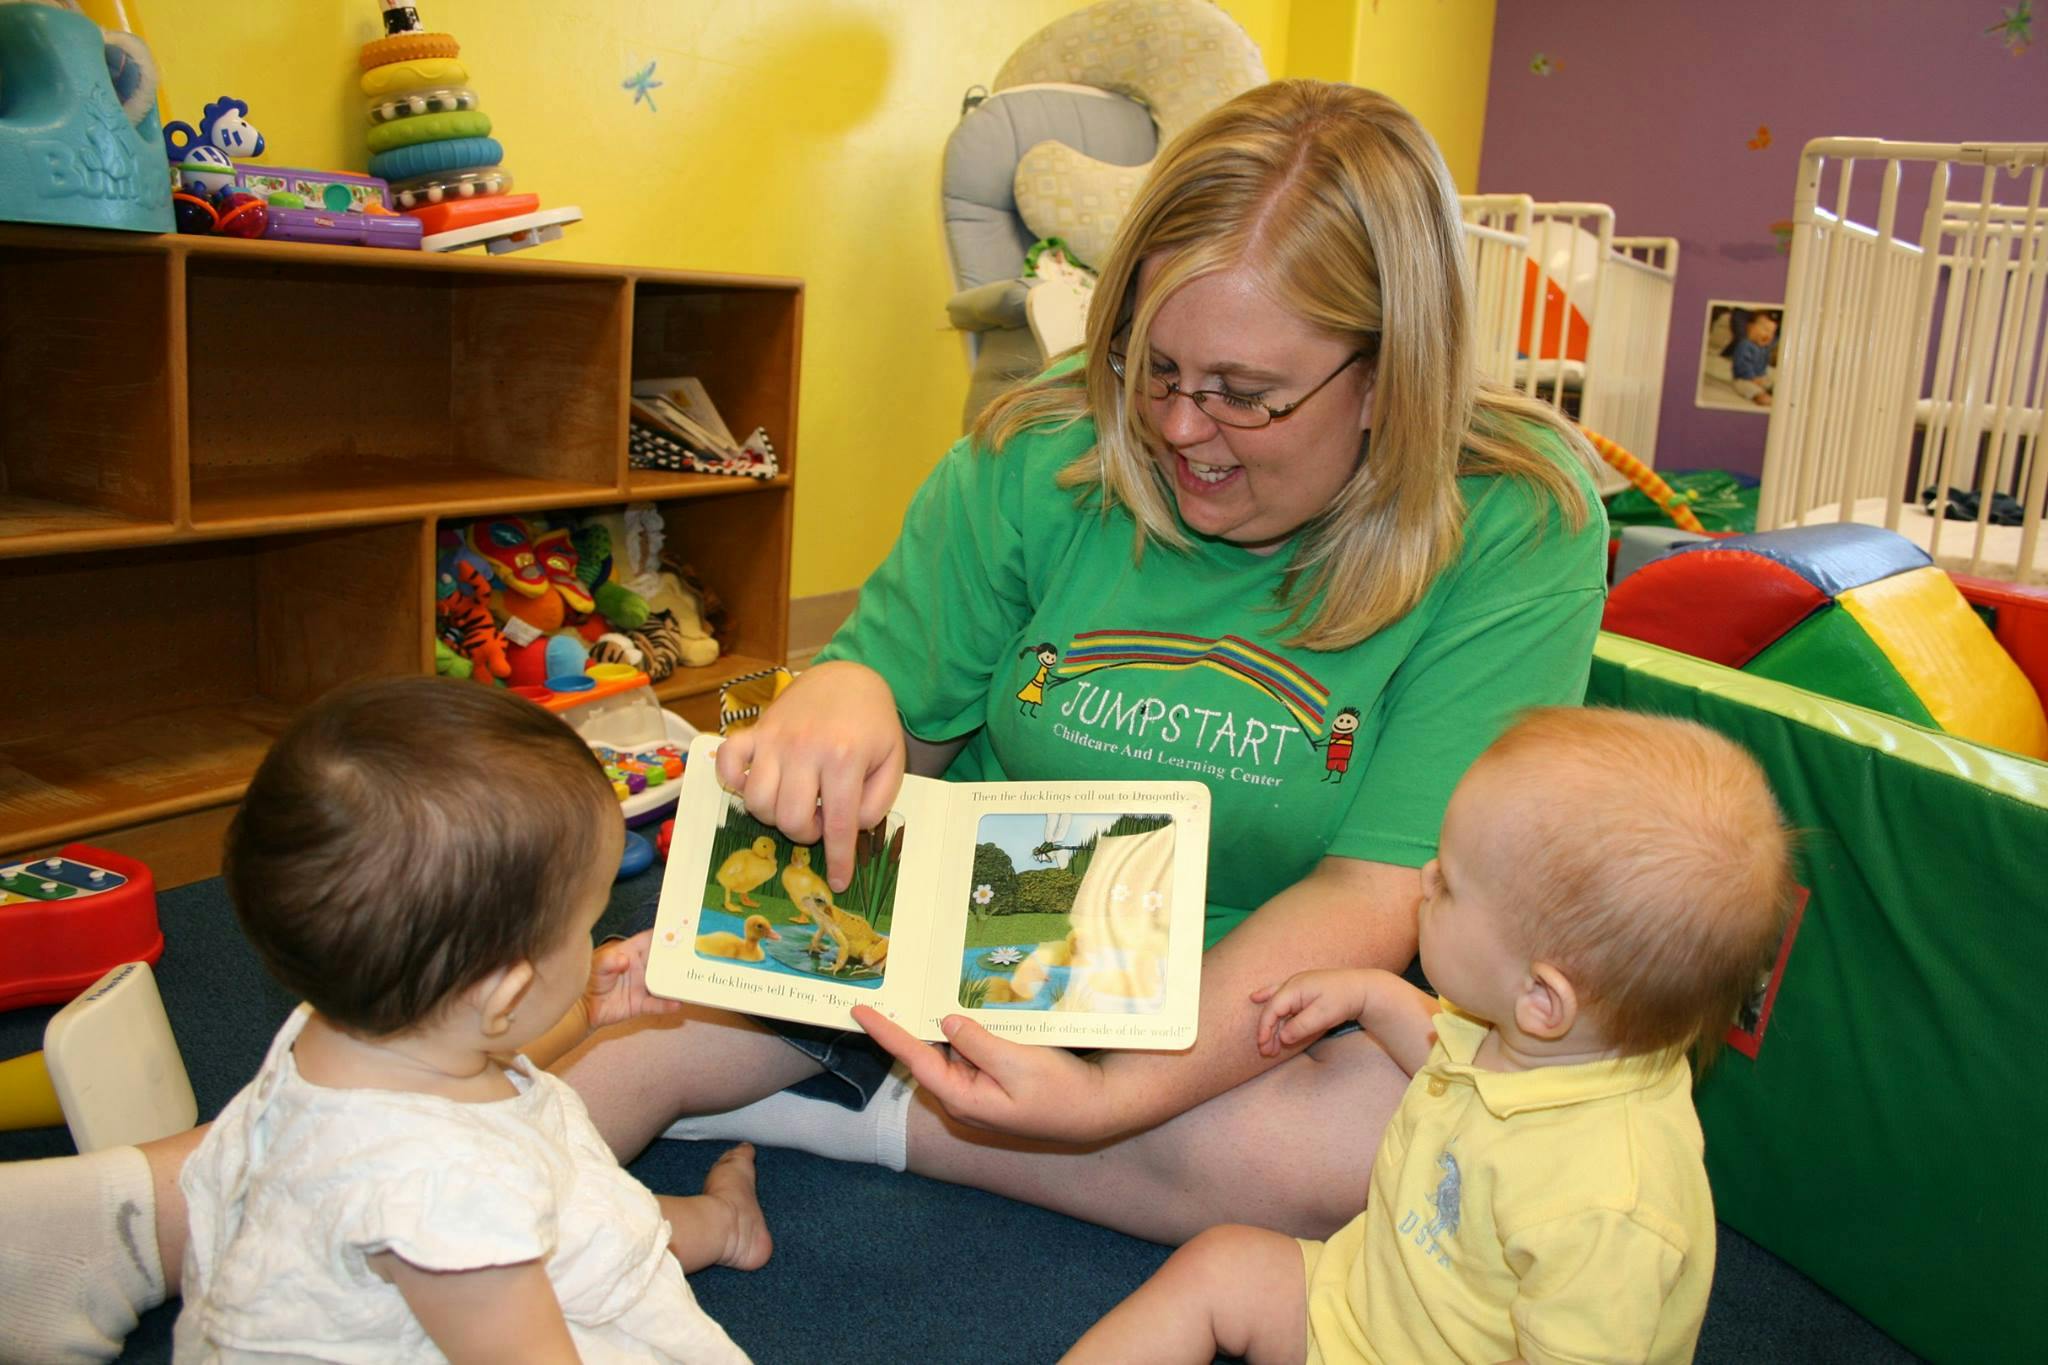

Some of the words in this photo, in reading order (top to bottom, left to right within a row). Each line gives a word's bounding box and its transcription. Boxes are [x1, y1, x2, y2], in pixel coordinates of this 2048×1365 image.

[1062, 681, 1299, 765] JUMPSTART
[1053, 723, 1119, 753] Childcare
[1120, 744, 1153, 761] And
[1157, 751, 1226, 779] Learning
[1230, 767, 1284, 787] Center
[971, 791, 997, 801] Then
[1000, 791, 1017, 801] the
[1020, 790, 1071, 803] ducklings
[1074, 790, 1095, 801] call
[1098, 791, 1115, 801] out
[1118, 792, 1130, 801] to
[686, 968, 704, 982] the
[707, 971, 763, 994] ducklings
[766, 983, 786, 996] tell
[982, 1019, 1023, 1035] imming
[1025, 1023, 1036, 1033] to
[1039, 1021, 1057, 1033] the
[1058, 1023, 1087, 1035] other
[1090, 1024, 1112, 1036] side
[1114, 1024, 1128, 1036] of
[1129, 1025, 1147, 1037] the
